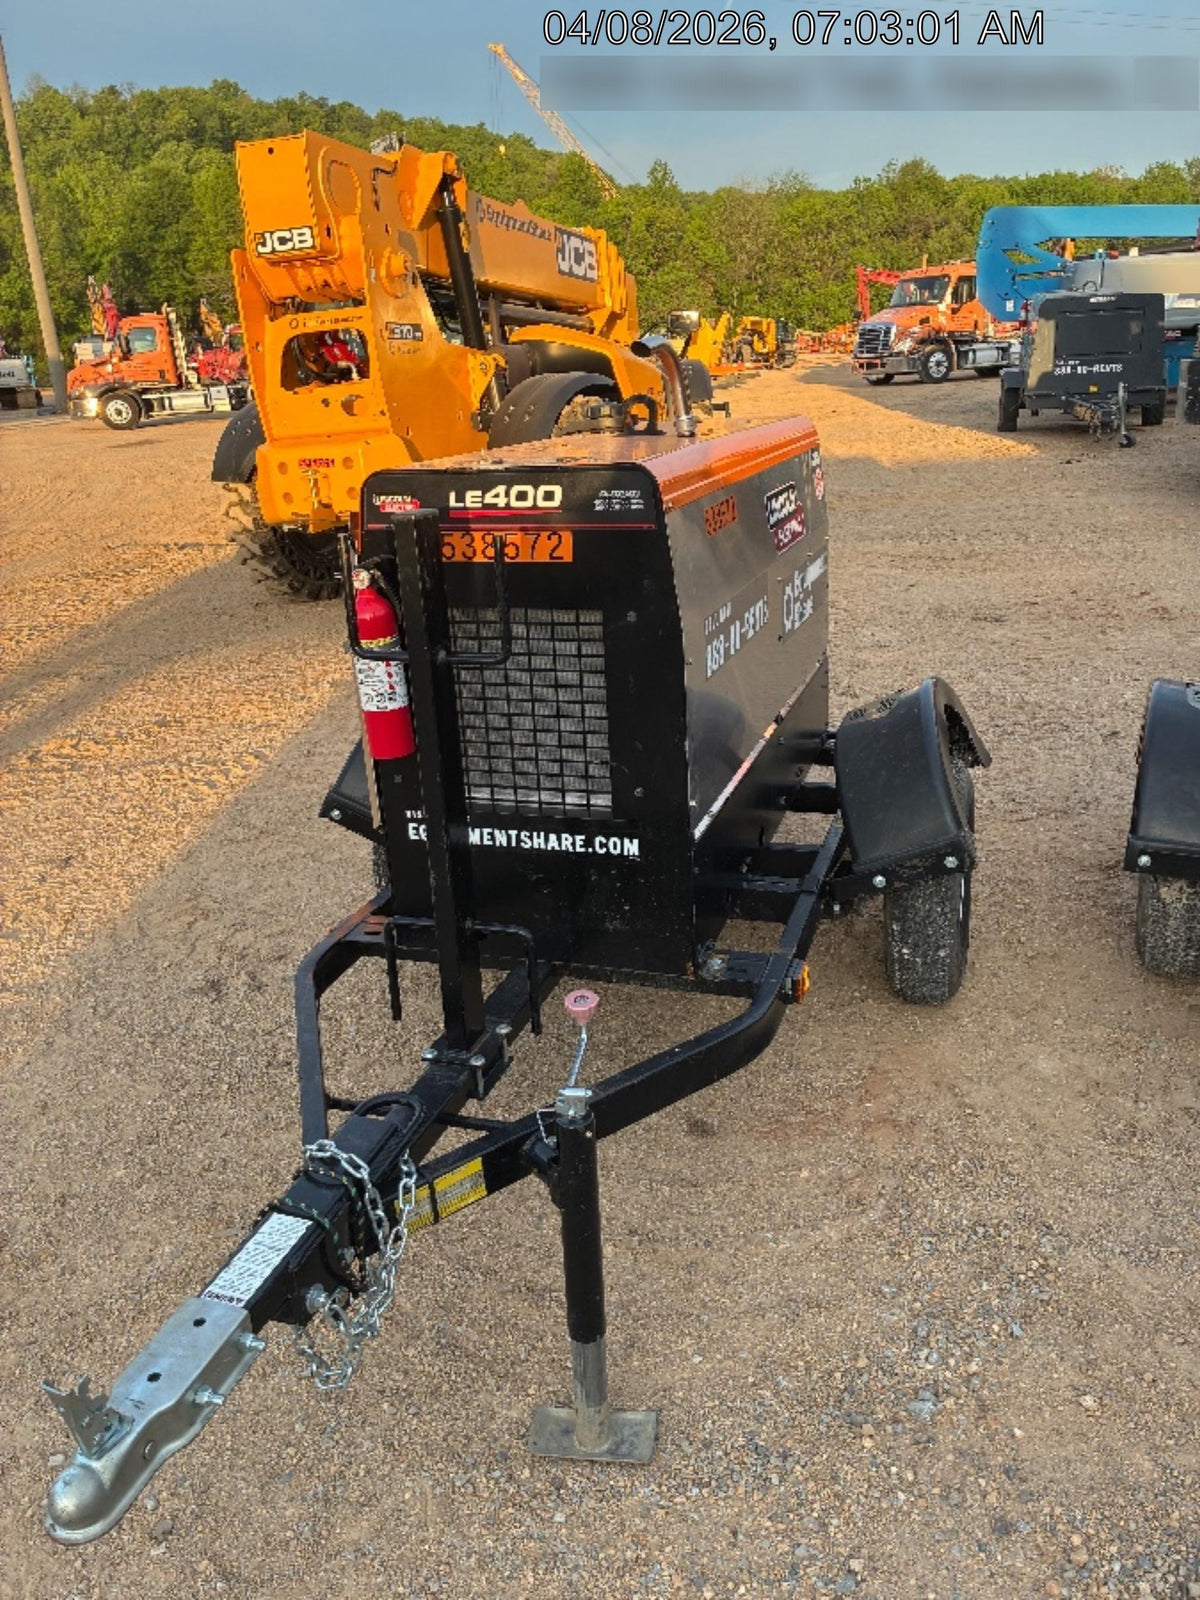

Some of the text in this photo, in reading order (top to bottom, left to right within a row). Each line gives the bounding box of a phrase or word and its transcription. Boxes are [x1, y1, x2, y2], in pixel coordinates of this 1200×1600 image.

[256, 226, 314, 254] JCB
[557, 234, 598, 280] JCB
[448, 485, 563, 508] LE400
[407, 822, 641, 858] EQMENTSHARE.COM
